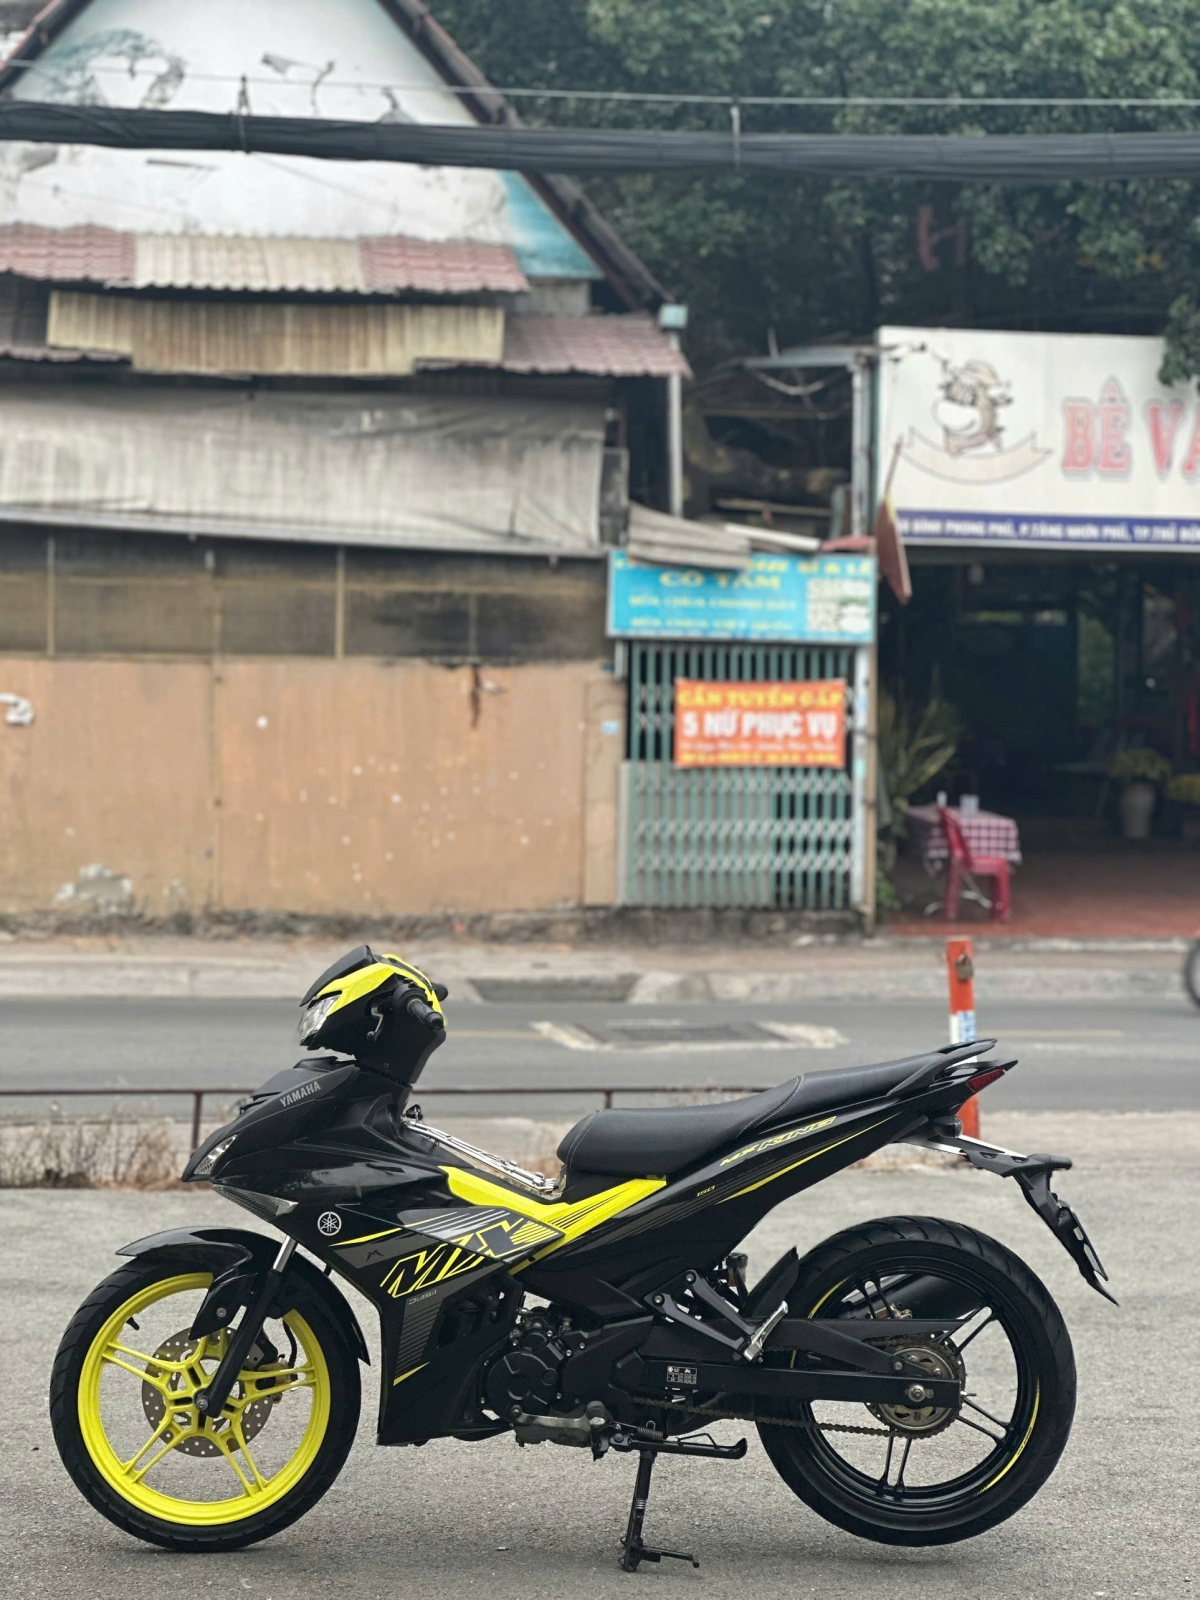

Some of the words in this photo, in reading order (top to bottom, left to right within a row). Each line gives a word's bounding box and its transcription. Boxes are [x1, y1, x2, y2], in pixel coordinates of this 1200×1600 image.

[1061, 375, 1131, 478] BÊ
[682, 711, 698, 738] 5
[741, 711, 803, 742] PHỤC
[806, 711, 838, 741] VỤ
[280, 1081, 321, 1107] YAMAHA
[757, 1115, 838, 1152] KING
[697, 1185, 715, 1197] 150
